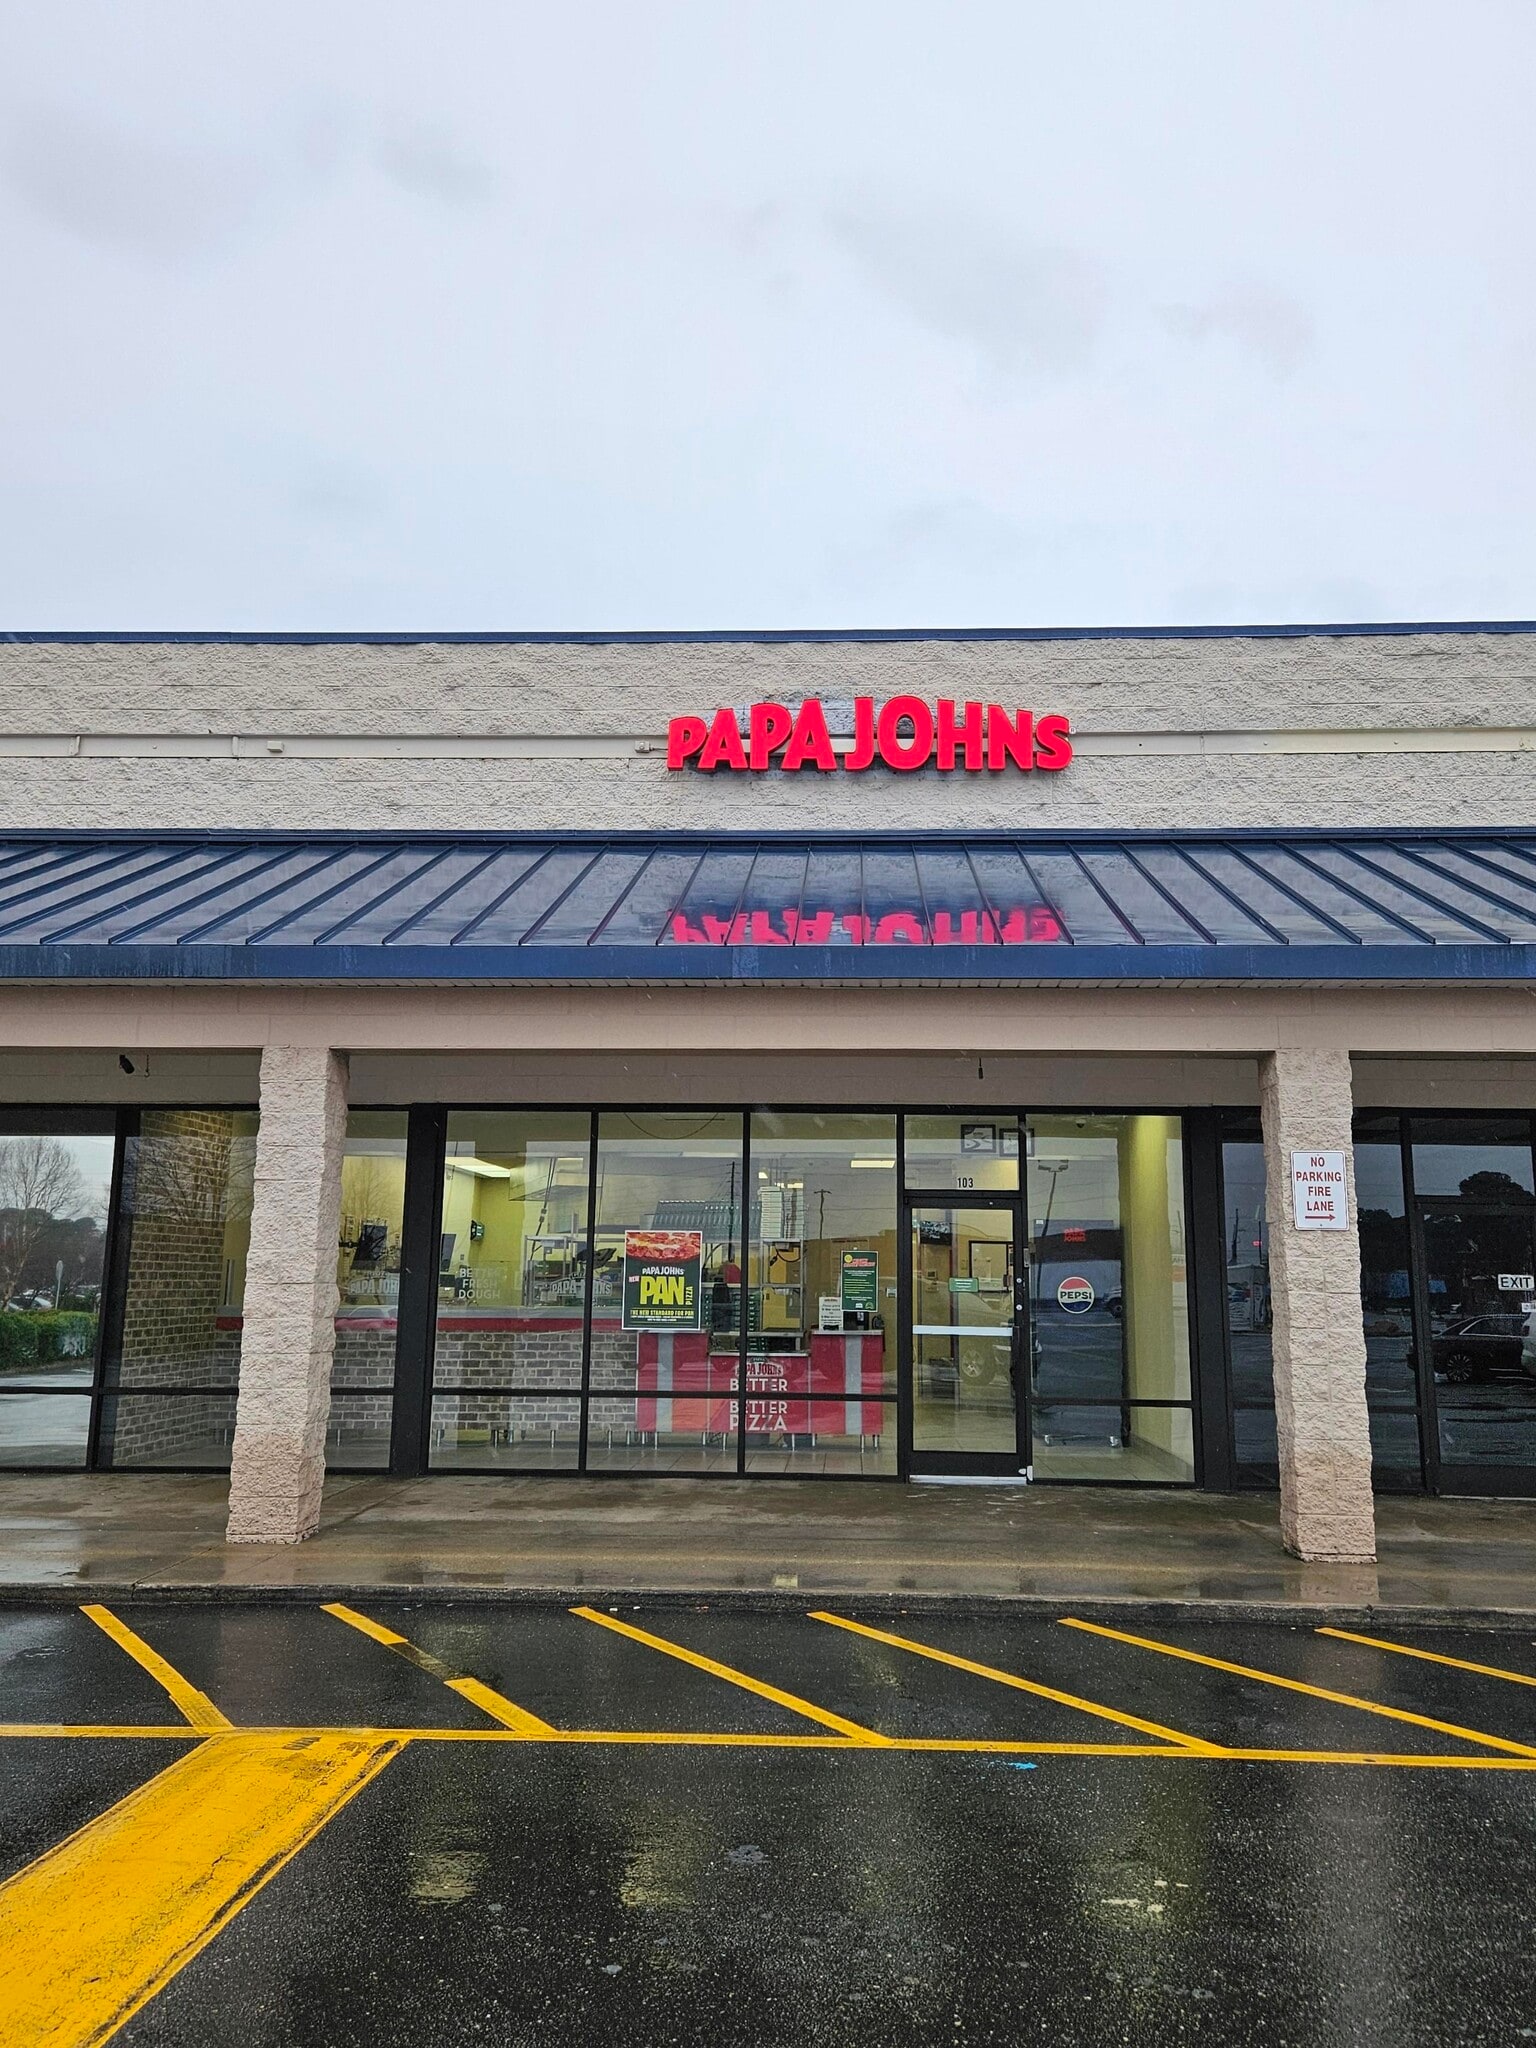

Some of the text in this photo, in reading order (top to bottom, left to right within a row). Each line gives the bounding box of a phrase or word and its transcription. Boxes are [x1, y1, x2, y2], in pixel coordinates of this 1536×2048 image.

[667, 695, 1073, 772] PAPA JOHNS
[1310, 1157, 1325, 1167] NO
[1296, 1171, 1342, 1182] PARKING
[957, 1177, 974, 1188] 103
[1308, 1186, 1331, 1196] FIRE
[1307, 1201, 1334, 1211] LANE
[642, 1266, 685, 1275] PAPA JOHNS
[462, 1279, 498, 1289] FRESH
[552, 1280, 577, 1294] PAPA
[1500, 1277, 1531, 1288] EXIT
[458, 1289, 501, 1299] DOUGH
[640, 1276, 685, 1305] PAN
[685, 1286, 693, 1305] PIZZA
[1060, 1291, 1092, 1300] PEPSI
